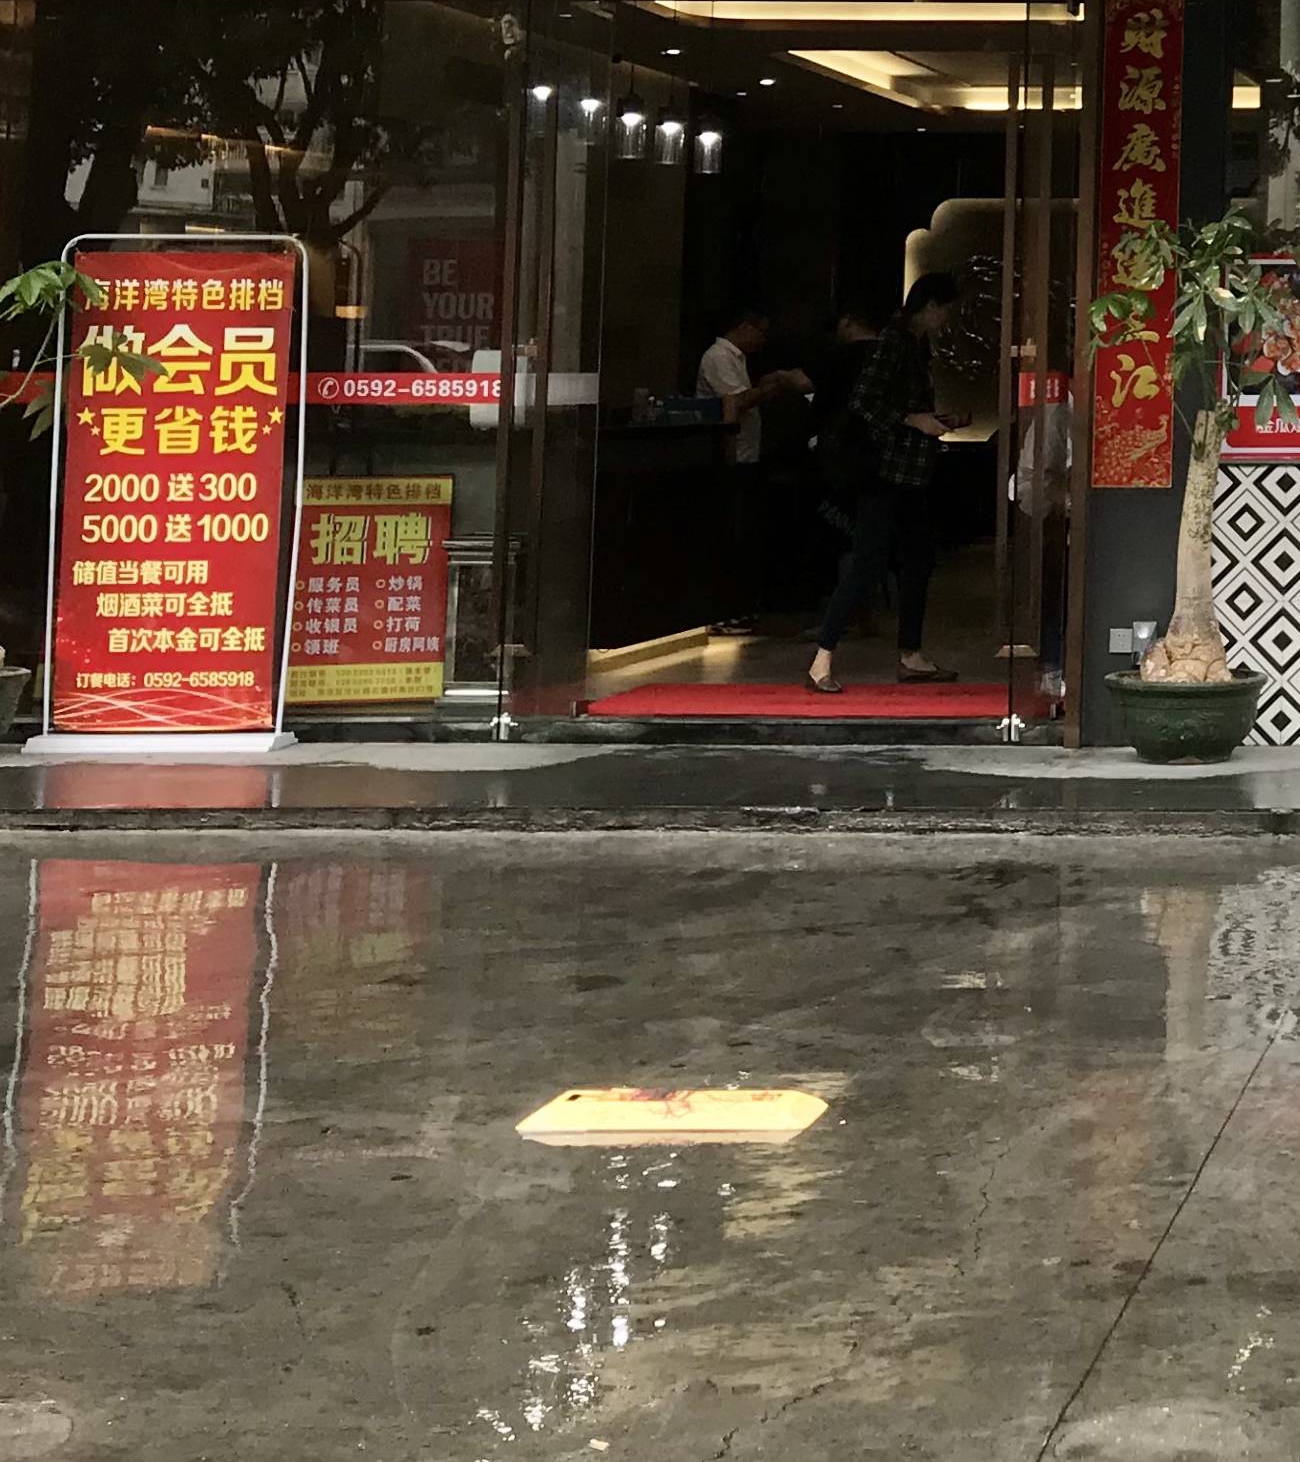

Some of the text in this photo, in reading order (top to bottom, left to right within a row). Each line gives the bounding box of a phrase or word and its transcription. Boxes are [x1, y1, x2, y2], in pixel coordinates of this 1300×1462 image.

[423, 258, 458, 286] BE
[423, 292, 495, 320] YOUR
[79, 323, 278, 397] 做会员
[99, 405, 258, 456] 更省钱
[84, 472, 257, 502] 2000 送 300
[306, 482, 442, 501] 海洋湾特色排档
[81, 513, 269, 543] 5000 送 1000
[310, 512, 433, 565] 招聘
[72, 560, 209, 586] 储值当餐可用
[308, 576, 360, 593] 服务员
[388, 575, 423, 591] 炒锅
[96, 592, 234, 618] 烟酒菜可全抵
[306, 597, 359, 614] 传菜员
[387, 596, 422, 612] 配菜
[305, 618, 358, 634] 收银员
[386, 616, 421, 632] 打荷
[108, 627, 266, 653] 首次本金可全抵
[304, 639, 340, 655] 领班
[143, 671, 255, 688] 0592-6585918
